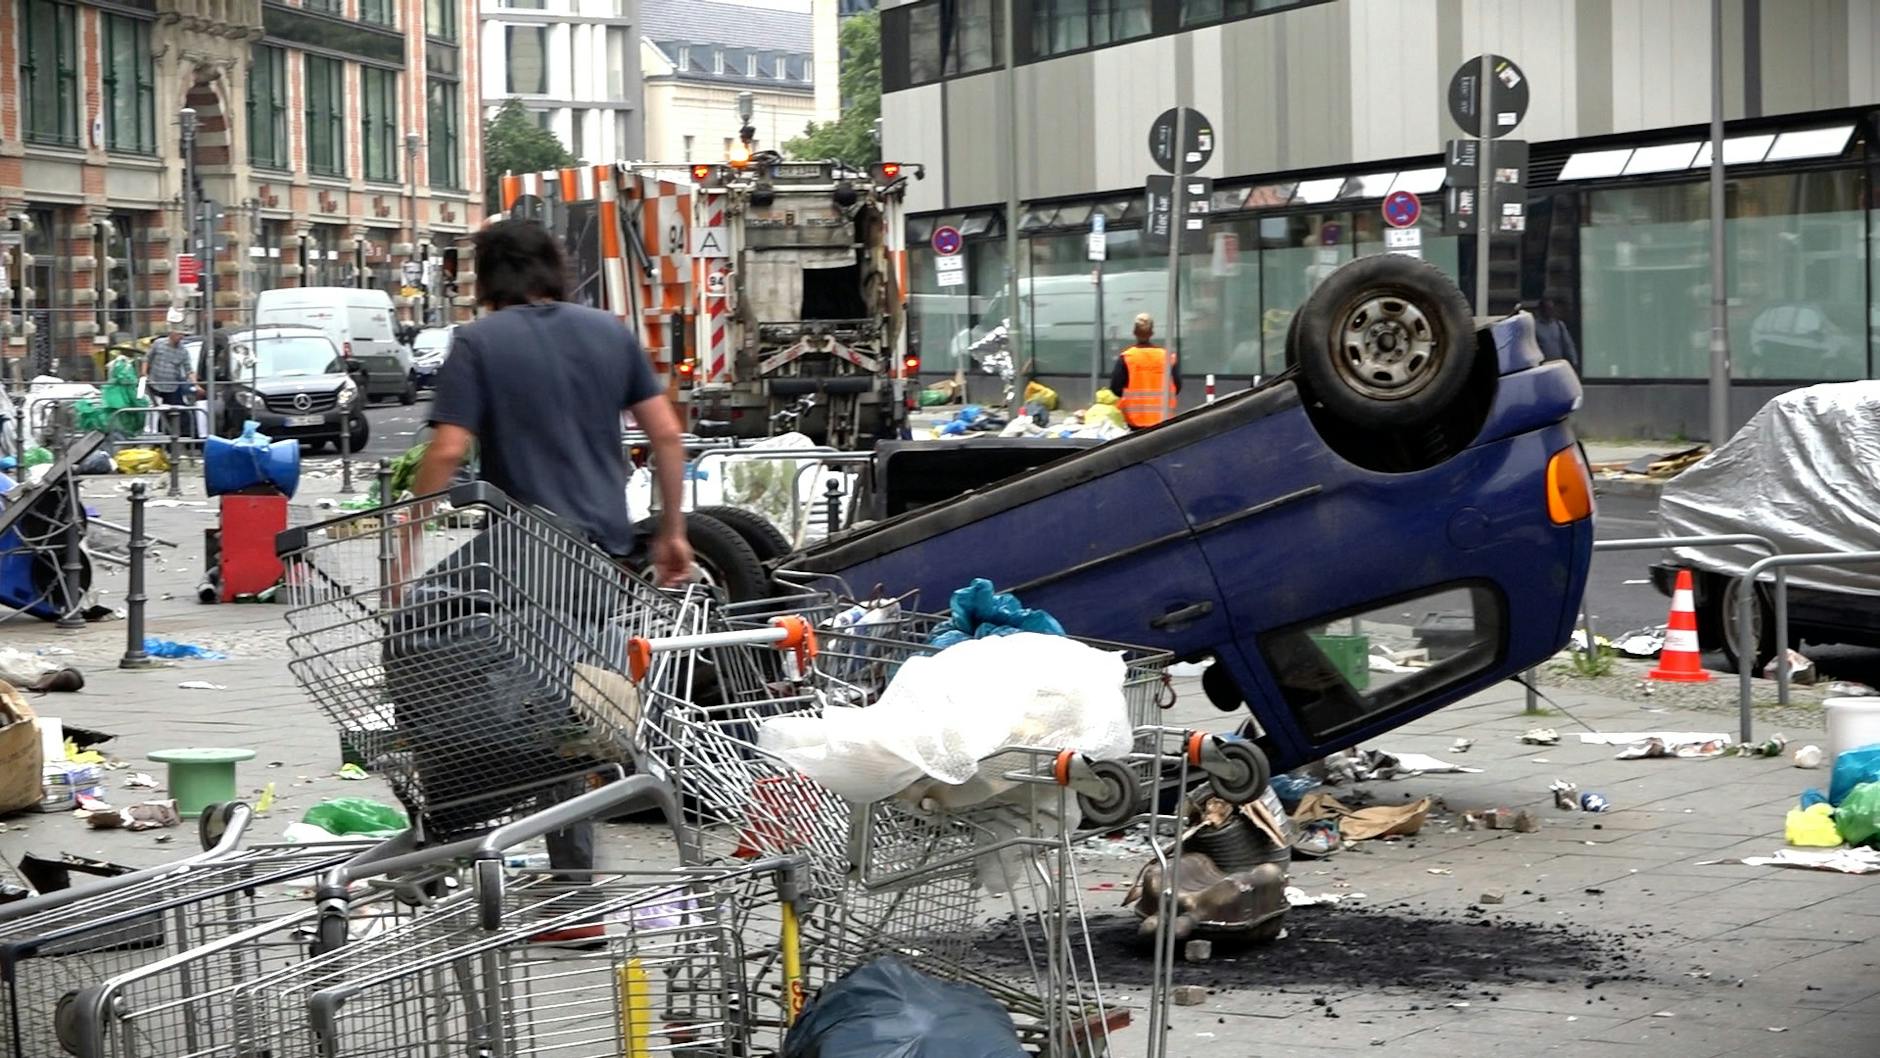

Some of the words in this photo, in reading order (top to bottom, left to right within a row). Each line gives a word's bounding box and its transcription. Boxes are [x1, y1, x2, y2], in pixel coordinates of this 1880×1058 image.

[669, 225, 684, 254] 94
[699, 231, 722, 252] A
[710, 276, 724, 286] 94
